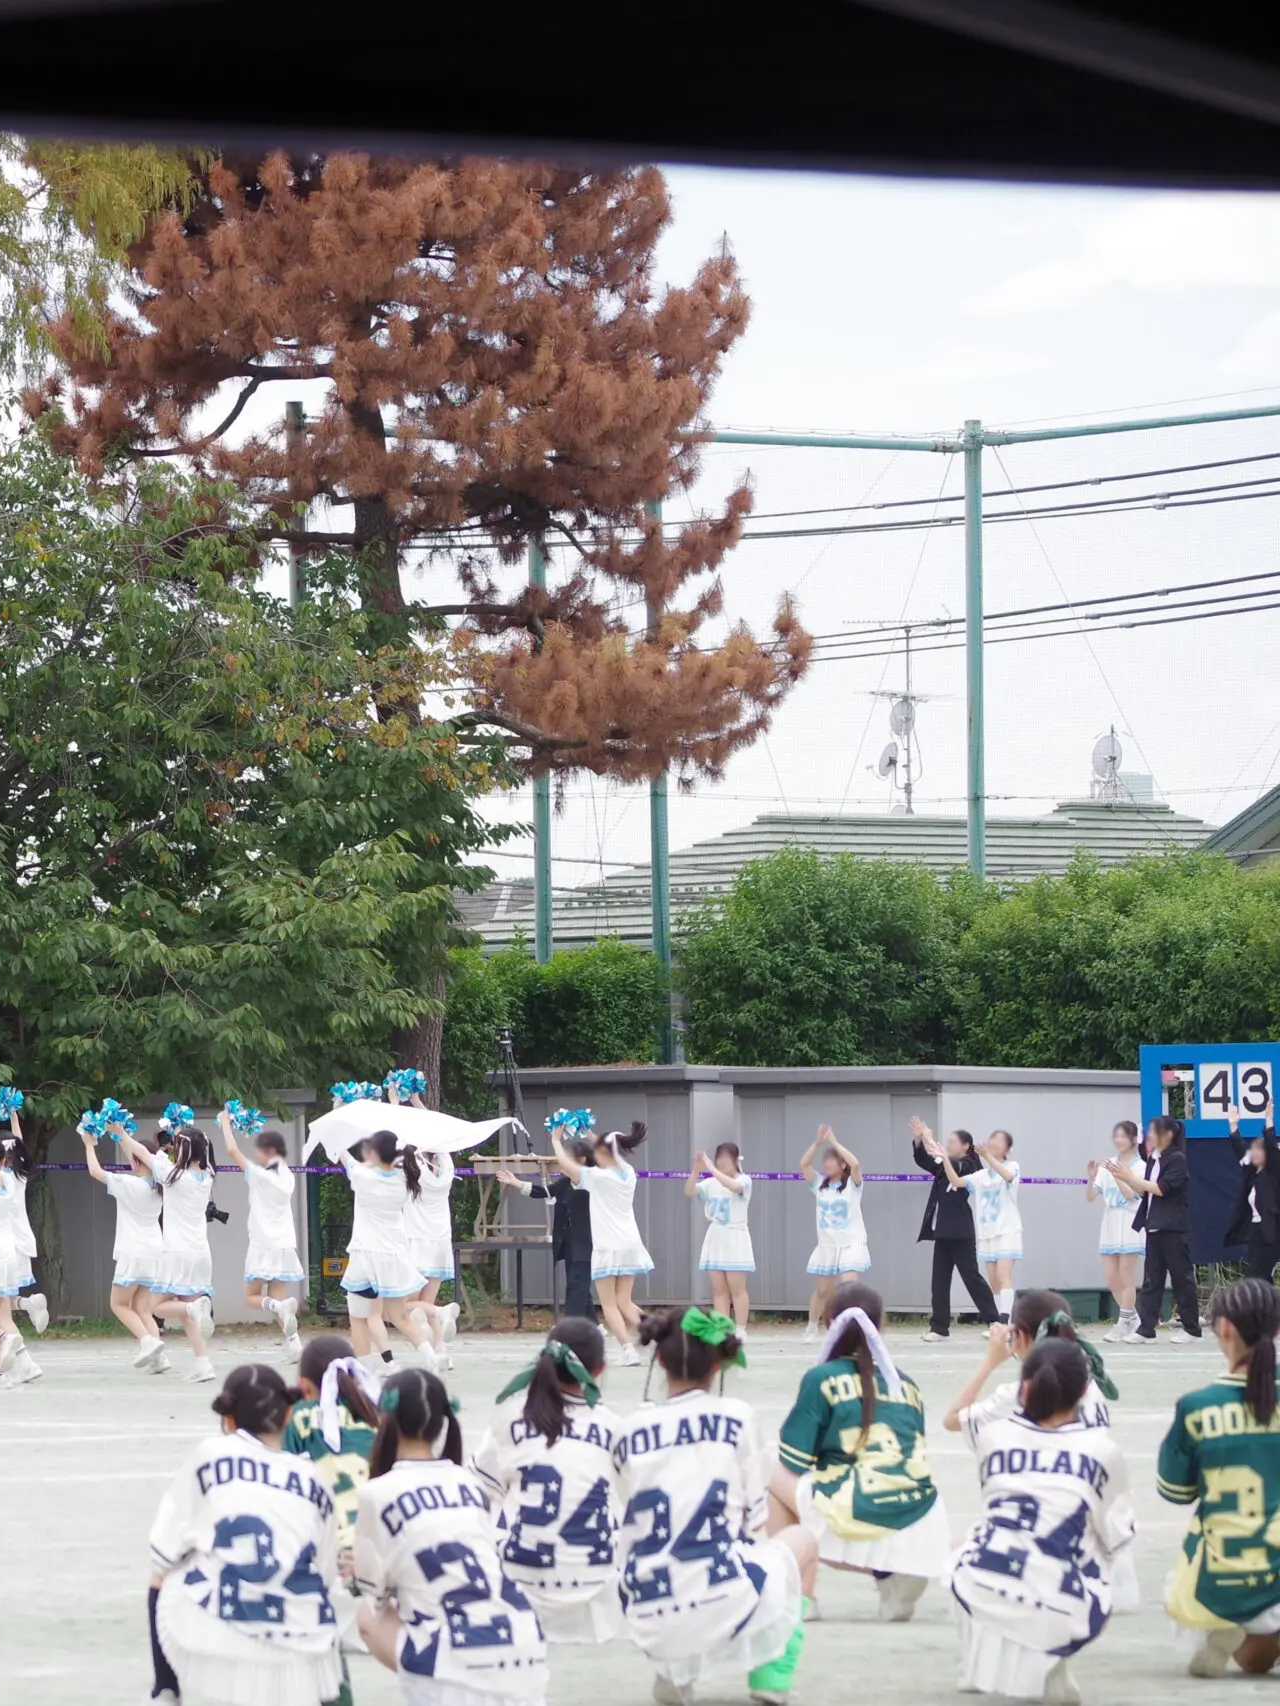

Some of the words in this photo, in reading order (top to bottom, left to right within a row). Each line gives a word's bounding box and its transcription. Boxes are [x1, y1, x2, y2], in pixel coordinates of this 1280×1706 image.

[1203, 1067, 1270, 1113] 43
[504, 1464, 613, 1568] 24
[623, 1478, 740, 1604] 24
